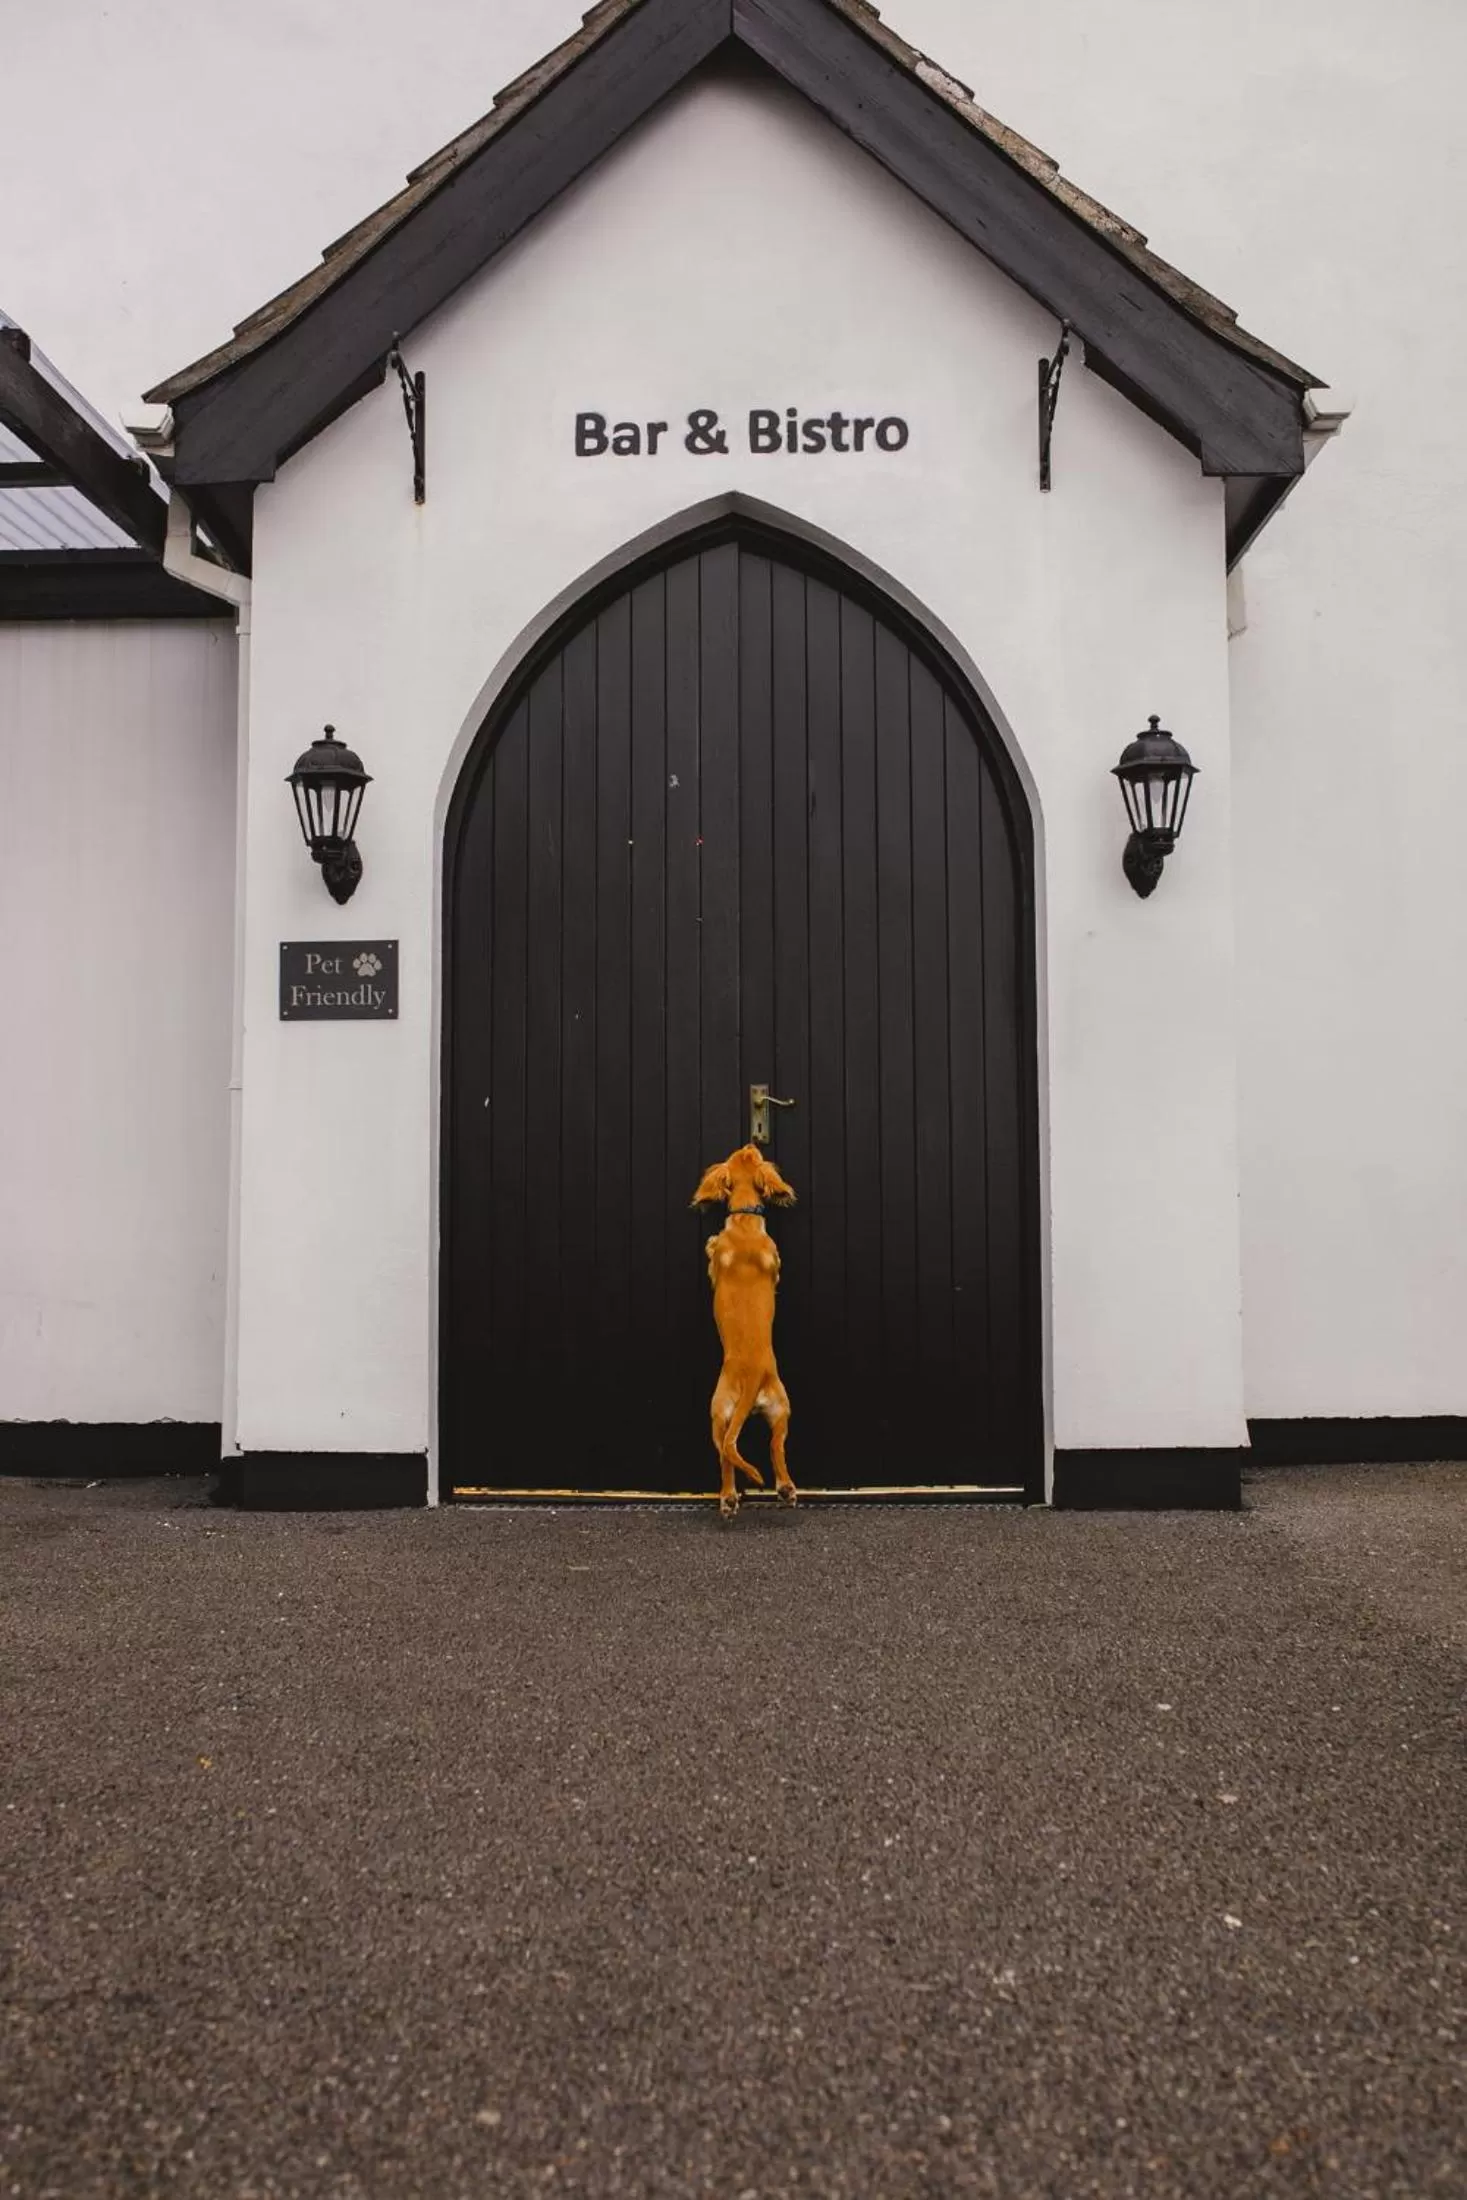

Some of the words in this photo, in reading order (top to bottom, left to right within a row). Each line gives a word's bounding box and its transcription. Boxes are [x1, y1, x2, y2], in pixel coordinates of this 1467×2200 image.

[574, 411, 668, 457] Bar
[683, 408, 729, 456] &
[748, 406, 910, 455] Bistro
[304, 953, 344, 975] Pet
[290, 983, 387, 1010] Friendly
